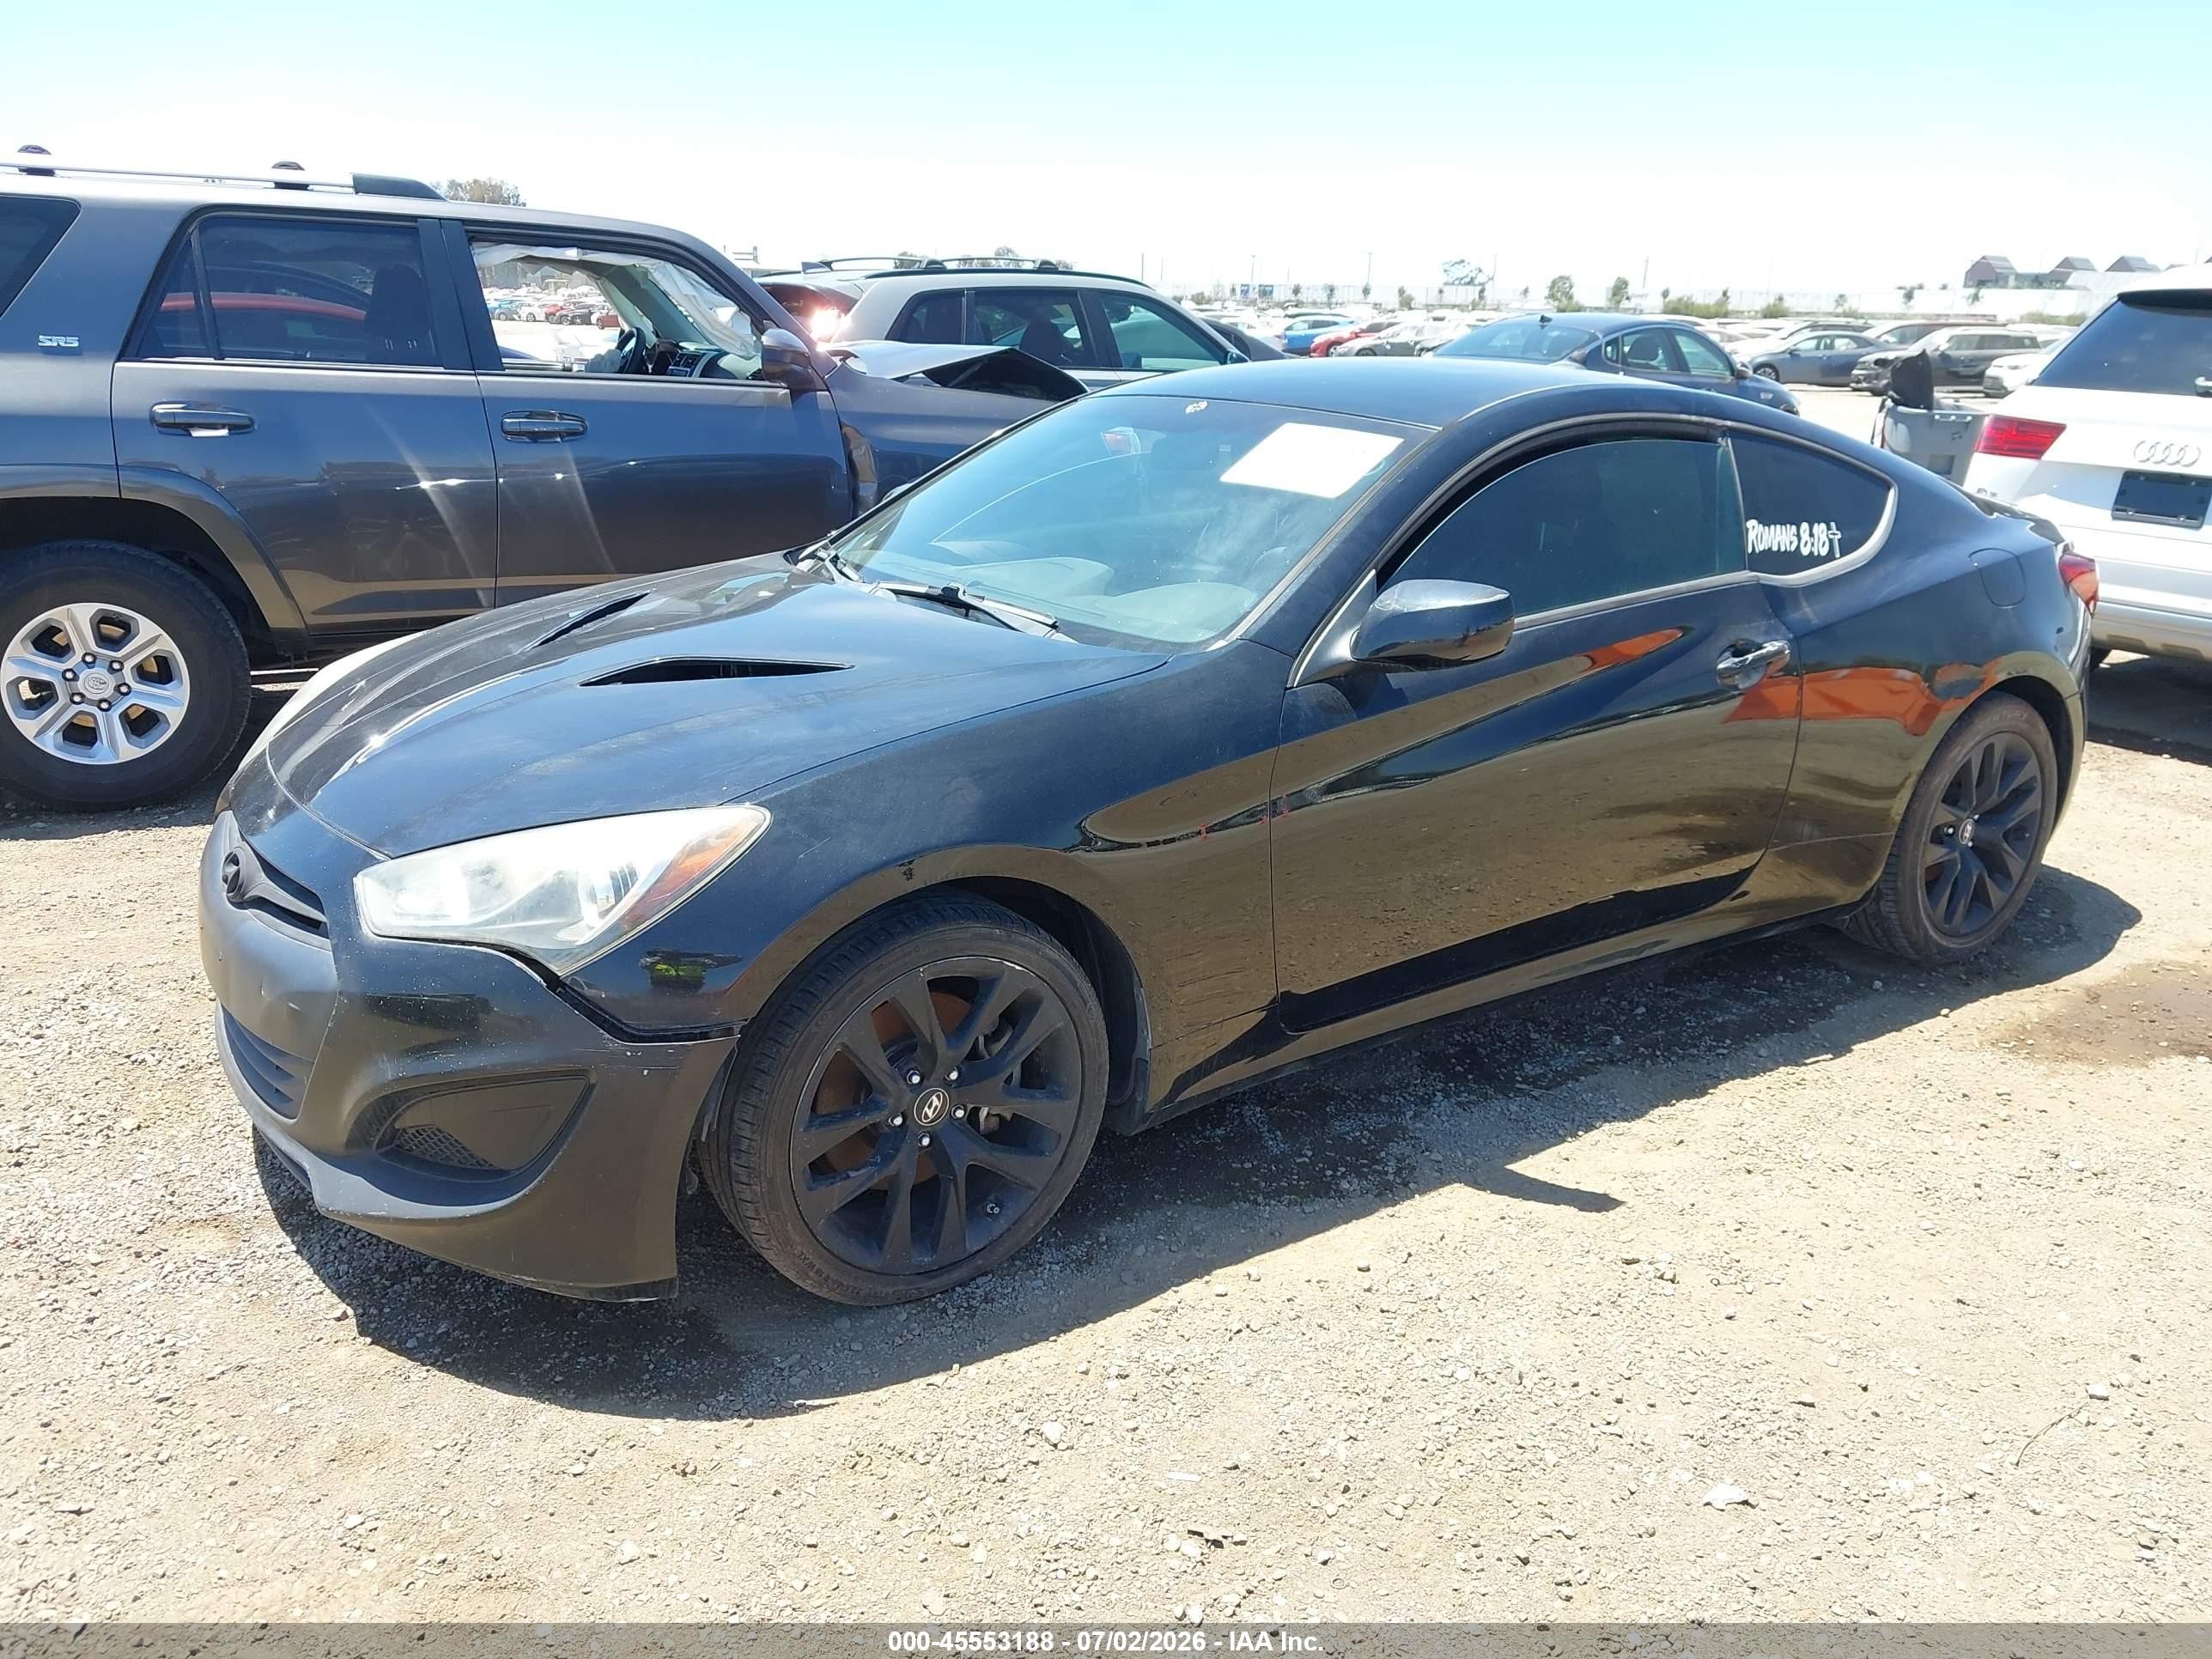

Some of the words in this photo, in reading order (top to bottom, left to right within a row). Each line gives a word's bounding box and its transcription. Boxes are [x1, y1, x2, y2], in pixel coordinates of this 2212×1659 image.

[38, 335, 79, 347] SR5
[1746, 519, 1798, 554] ROMANS
[1800, 521, 1830, 556] 8:18
